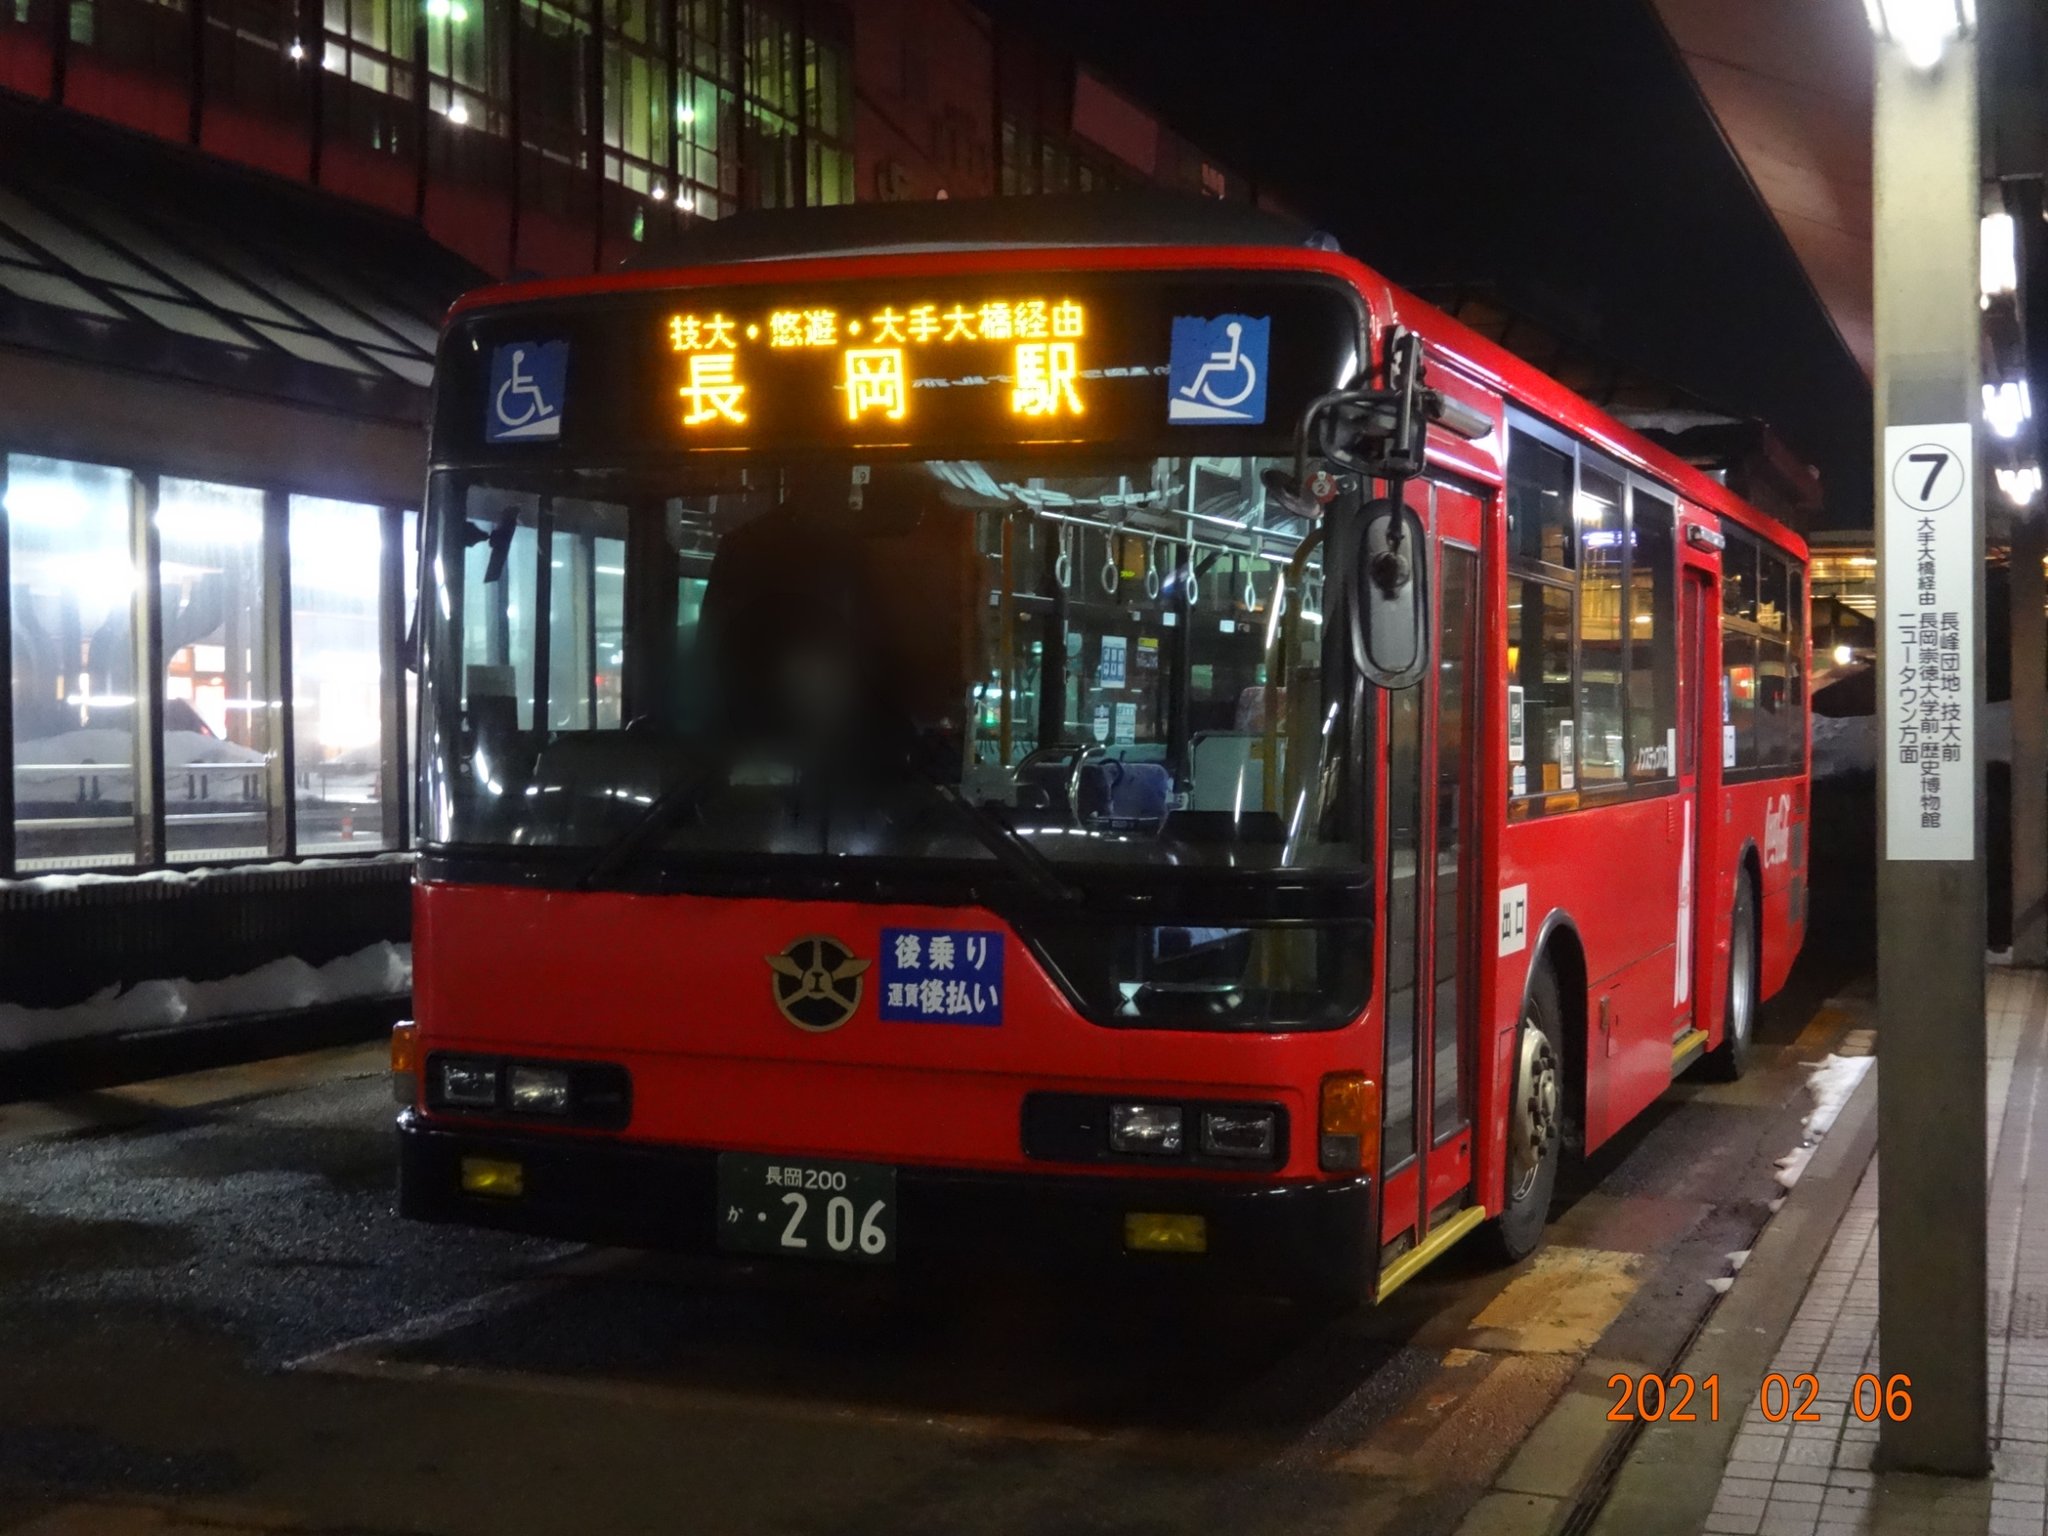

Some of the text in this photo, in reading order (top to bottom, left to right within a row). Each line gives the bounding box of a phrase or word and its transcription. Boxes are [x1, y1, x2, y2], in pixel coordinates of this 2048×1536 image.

[1909, 453, 1949, 502] 7
[1917, 517, 1936, 606] 大手大橋経由
[1898, 613, 1919, 764] ニュータウン方面
[1918, 612, 1941, 828] 長岡崇徳大学前・歴史博物館
[1940, 612, 1961, 762] 長峰団地・技大前
[894, 934, 987, 971] 後乗り
[1502, 899, 1525, 939] 出口
[887, 978, 999, 1015] 運賃後払い
